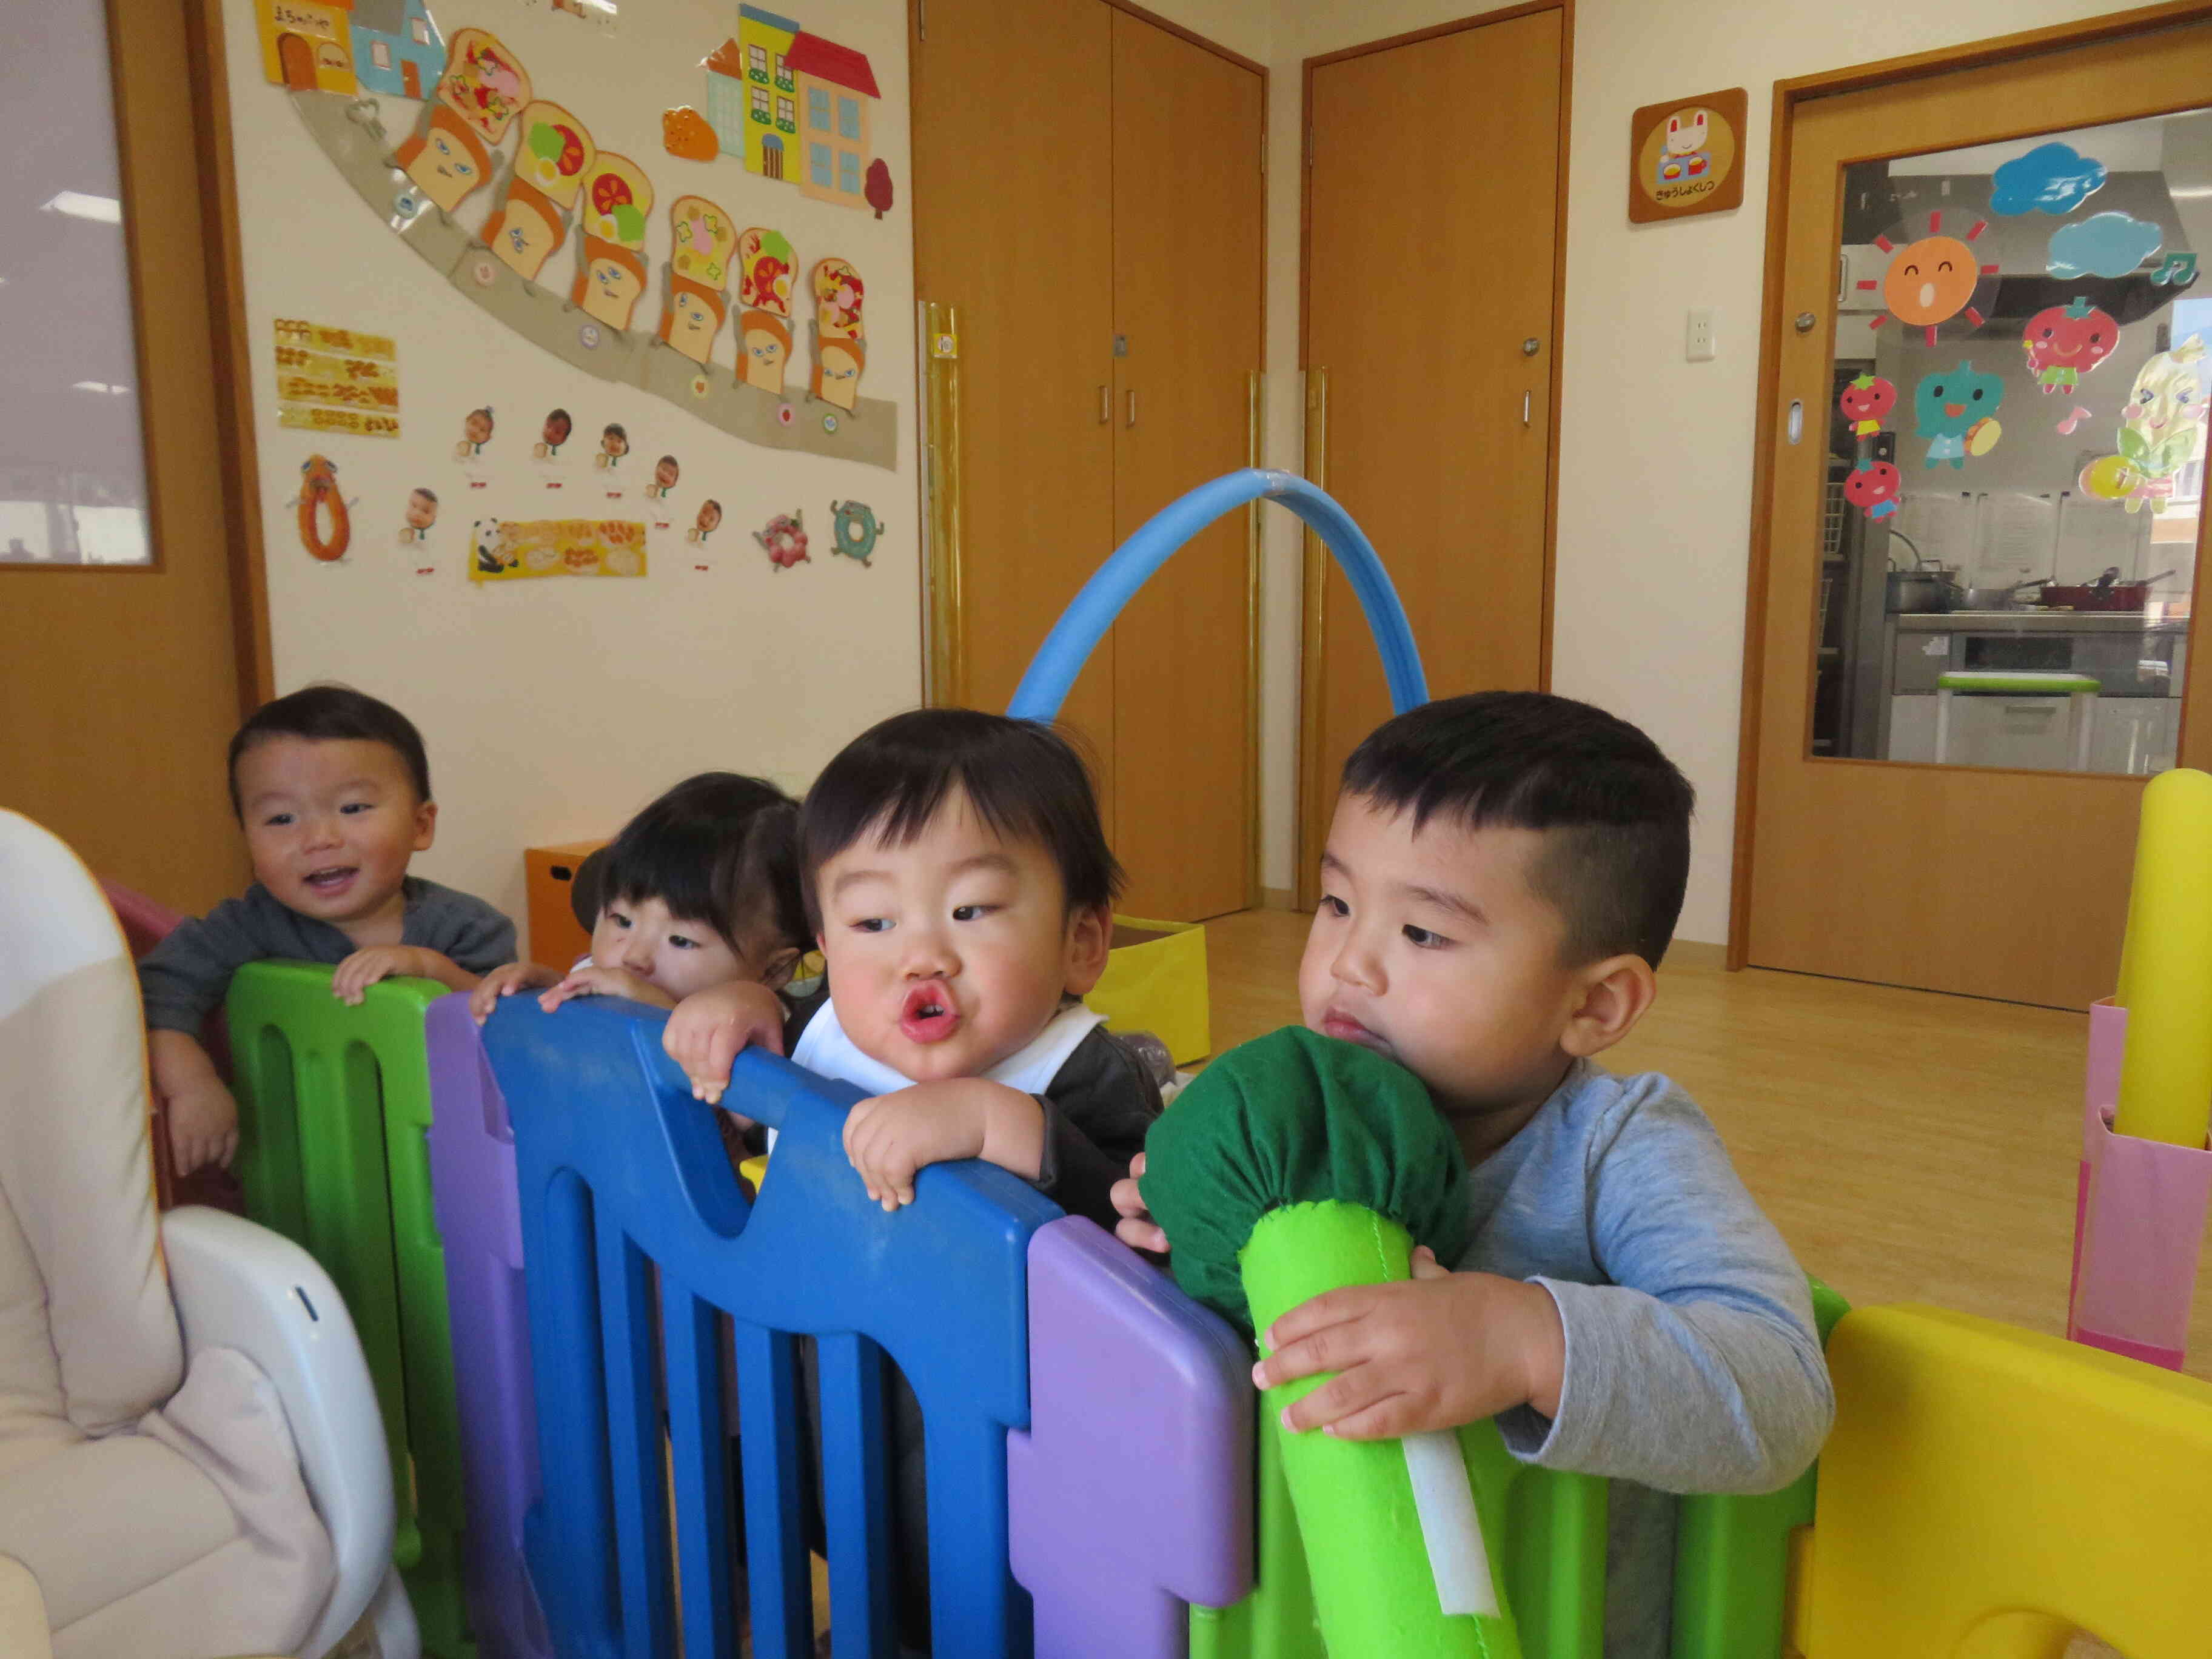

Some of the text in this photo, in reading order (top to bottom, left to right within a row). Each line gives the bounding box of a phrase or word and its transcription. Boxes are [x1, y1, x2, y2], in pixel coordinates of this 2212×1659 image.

[1656, 180, 1715, 200] きゅうしょくしつ
